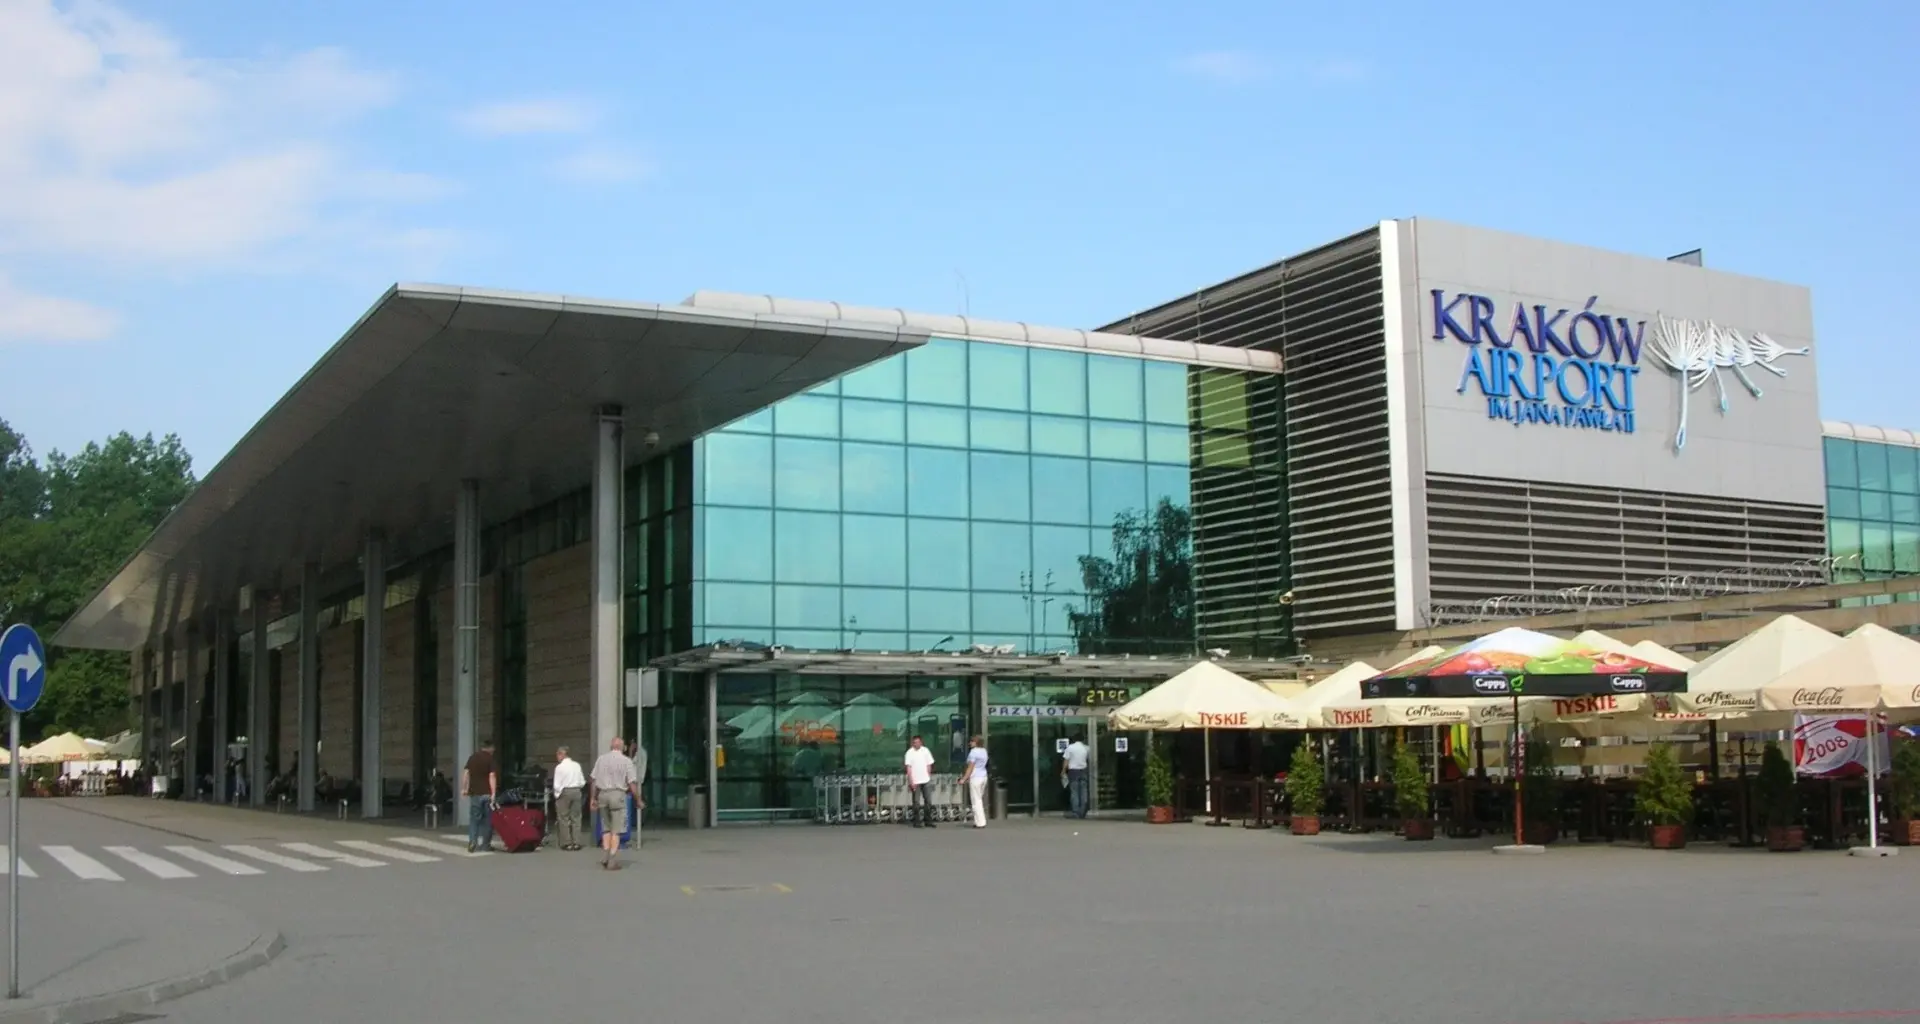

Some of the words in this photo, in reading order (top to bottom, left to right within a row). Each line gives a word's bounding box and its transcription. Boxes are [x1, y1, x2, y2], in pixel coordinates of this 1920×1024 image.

[1431, 289, 1647, 365] KRAKÓW
[1457, 346, 1640, 412] AIRPORT
[1514, 399, 1562, 429] JANA
[1475, 677, 1507, 690] Cappy
[1612, 676, 1644, 689] Cappy
[1552, 694, 1619, 716] TYSKIE
[1694, 690, 1732, 706] Coffee
[988, 706, 1080, 716] PRZYLOTY
[1198, 712, 1248, 725] TYSKIE
[1332, 708, 1374, 725] TYSKIE
[1405, 704, 1440, 717] Coffee
[1805, 735, 1850, 765] 2008
